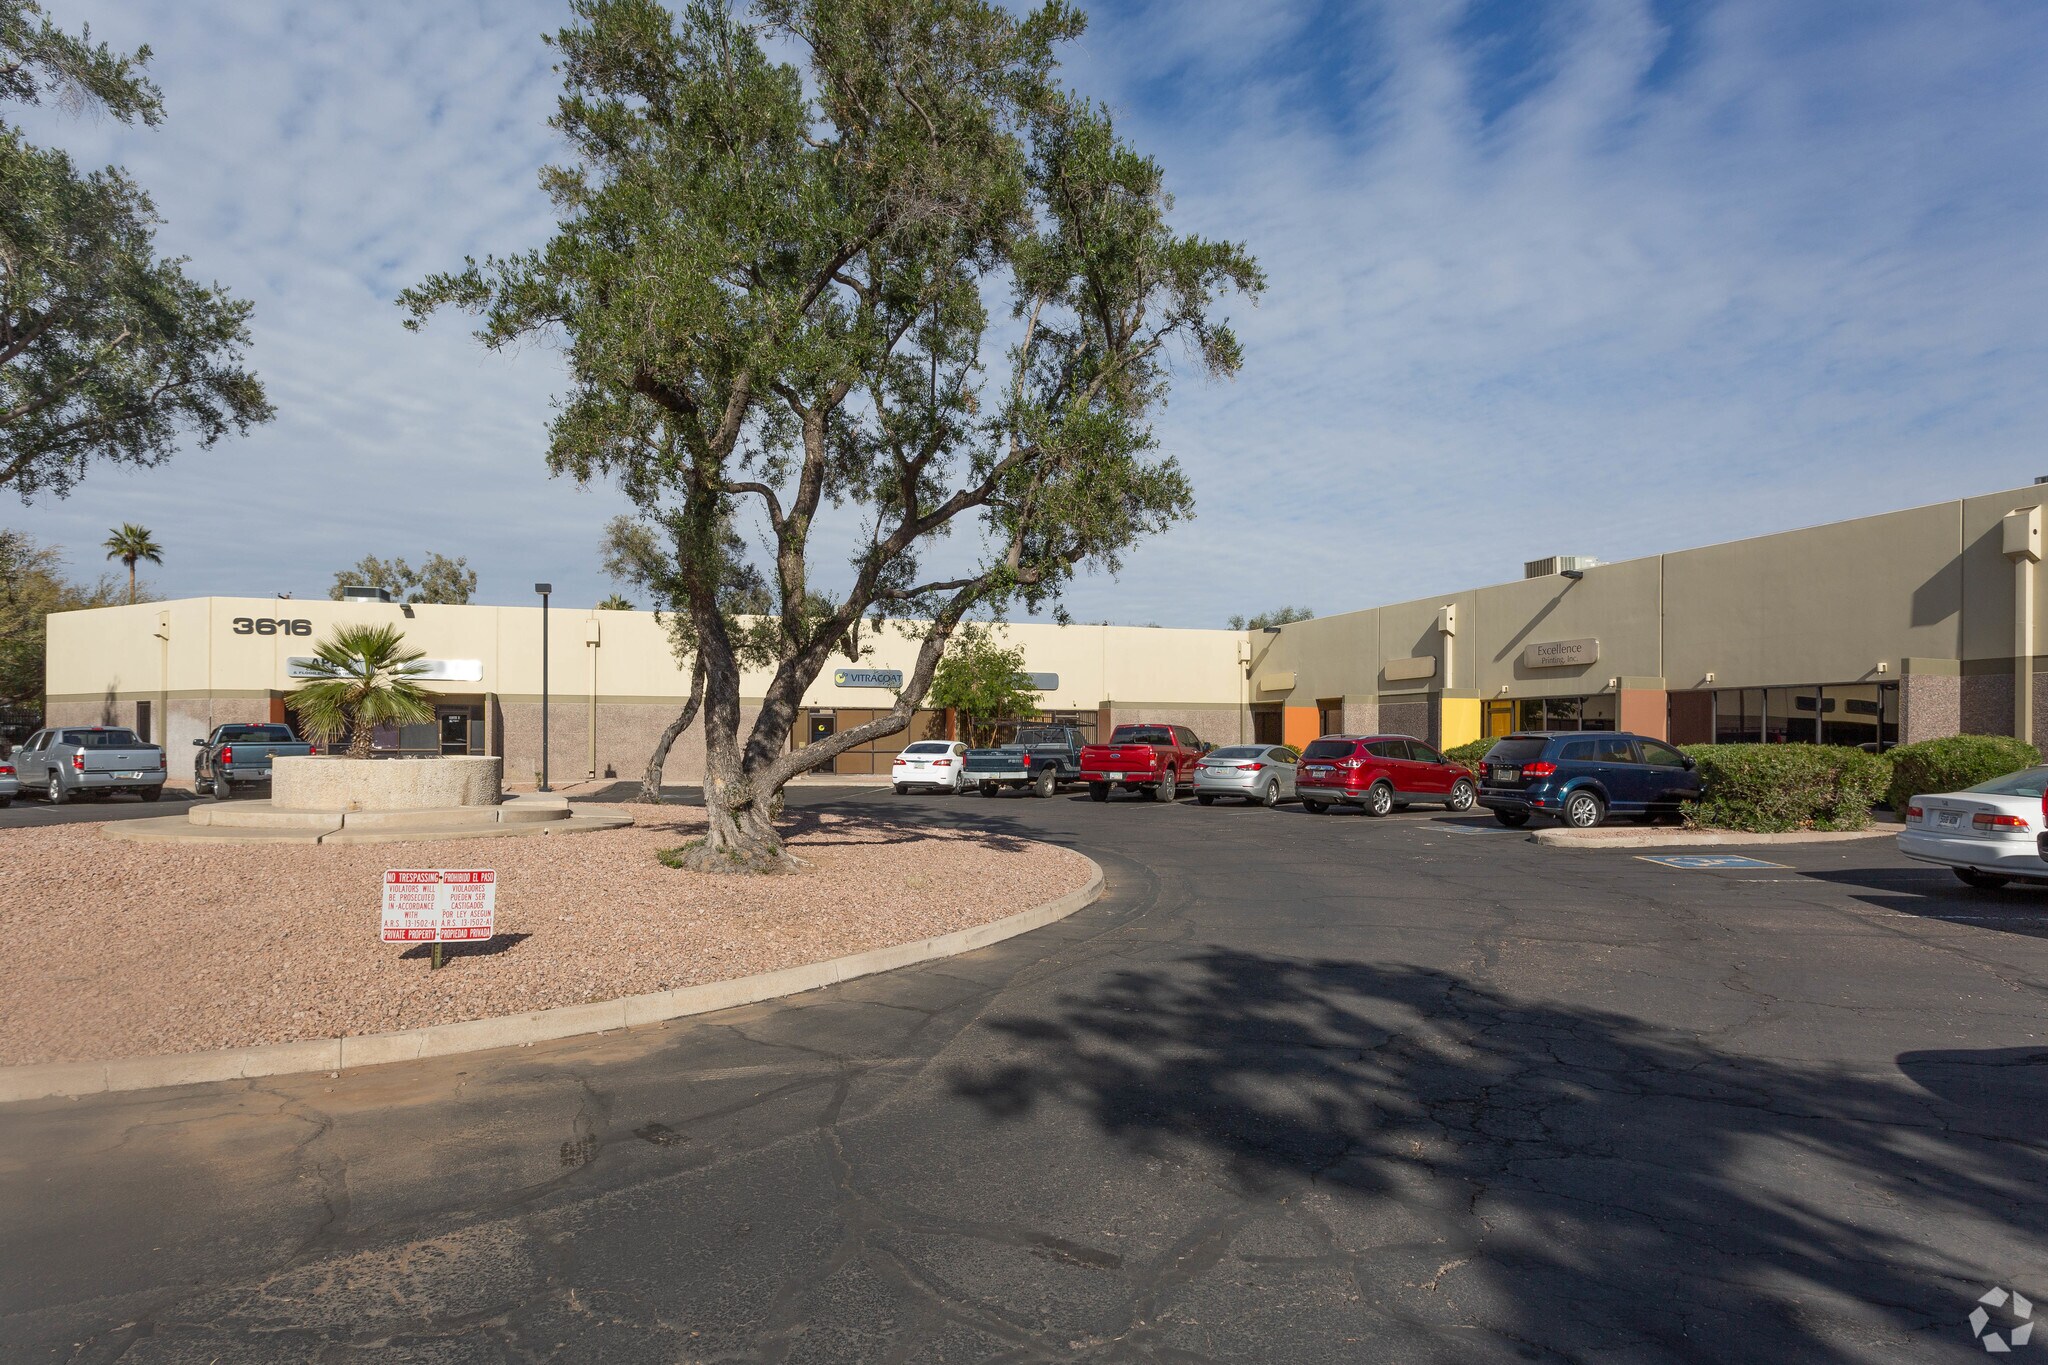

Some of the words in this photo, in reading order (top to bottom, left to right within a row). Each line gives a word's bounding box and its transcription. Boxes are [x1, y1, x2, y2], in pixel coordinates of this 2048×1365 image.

[233, 618, 312, 636] 3616
[1538, 644, 1582, 655] Excellence
[851, 674, 902, 682] VITRACOAT
[387, 873, 396, 882] NO
[399, 873, 438, 882] TRESPASSING
[445, 873, 470, 882] PROHIBIDO
[473, 873, 478, 882] EL
[481, 872, 494, 882] PASO
[384, 930, 405, 939] PRIVATE
[408, 930, 435, 939] PROPERTY
[441, 929, 468, 938] PROPIEDAD
[470, 928, 490, 938] PRIVADA
